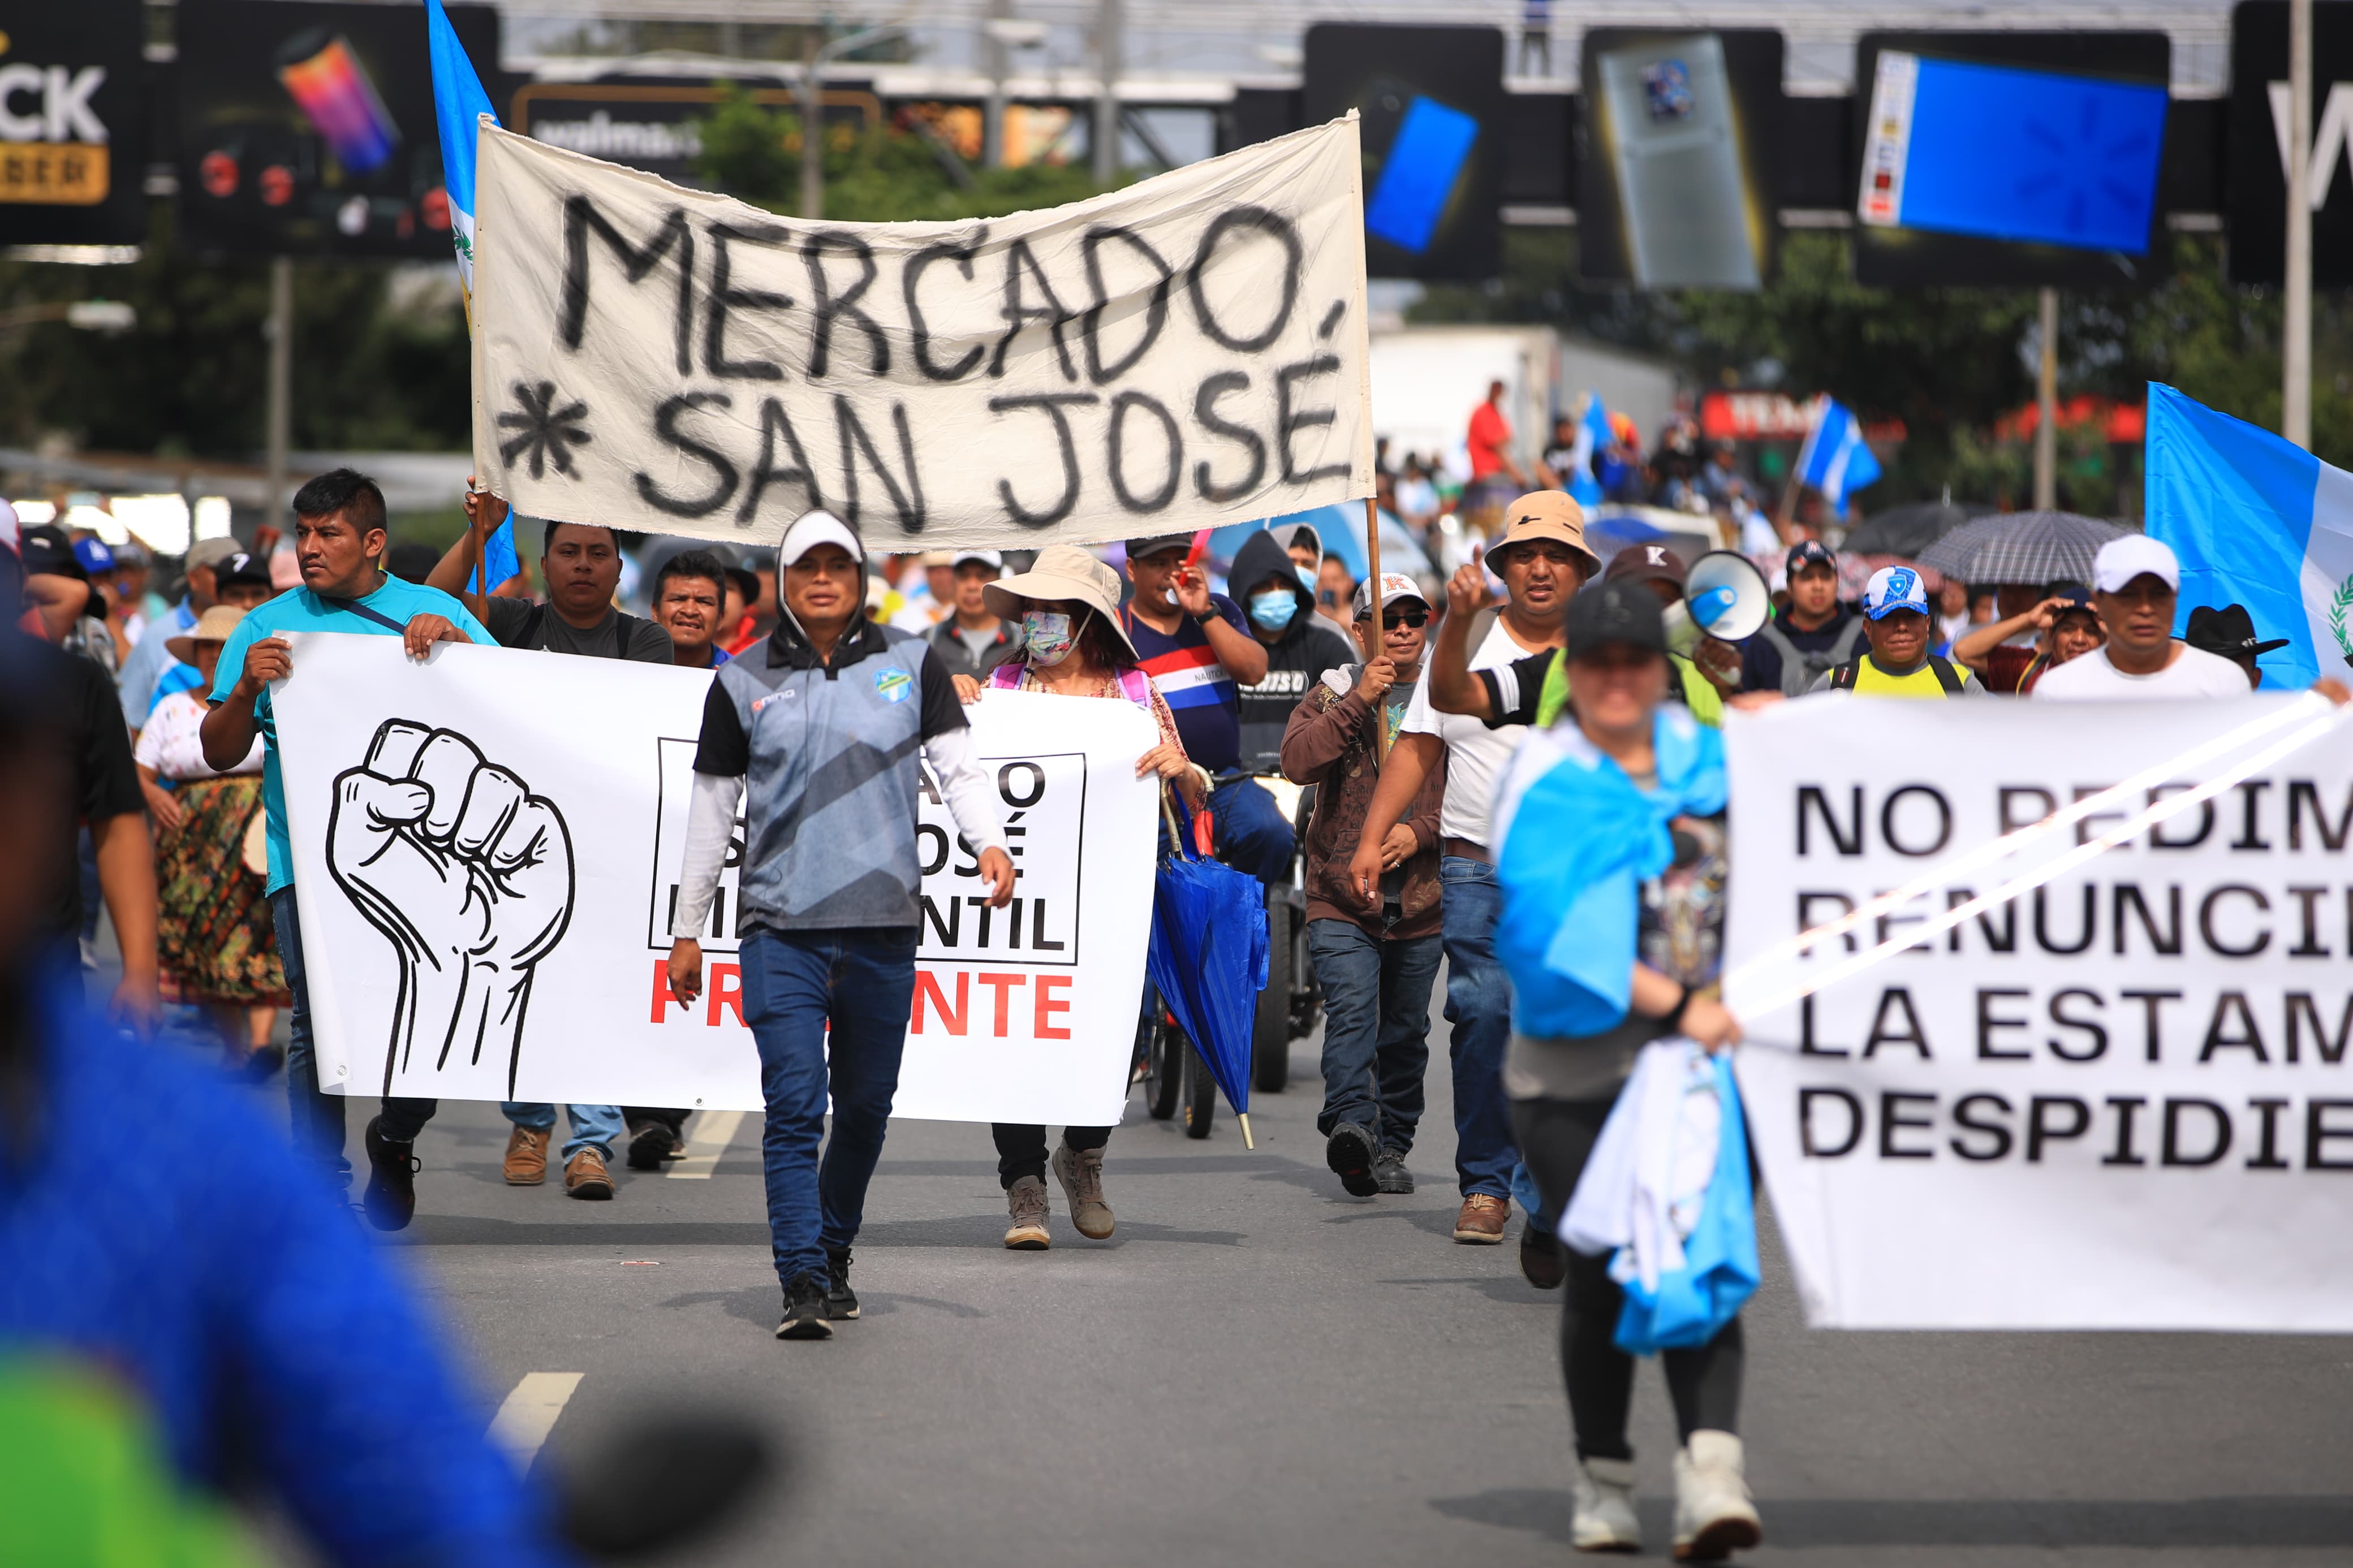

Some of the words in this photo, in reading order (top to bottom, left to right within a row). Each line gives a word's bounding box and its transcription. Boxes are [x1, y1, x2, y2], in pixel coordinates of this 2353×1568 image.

[557, 193, 1303, 386] MERCADO
[634, 390, 928, 536] SAN
[1382, 576, 1409, 591] K
[1645, 545, 1668, 567] K
[915, 811, 1027, 878] OSÉ
[1795, 784, 1953, 858] NO
[1795, 881, 2353, 958] RENUNCI
[1799, 987, 1932, 1060] LA
[1975, 987, 2353, 1064] ESTAM
[1798, 1086, 2353, 1172] DESPIDIE
